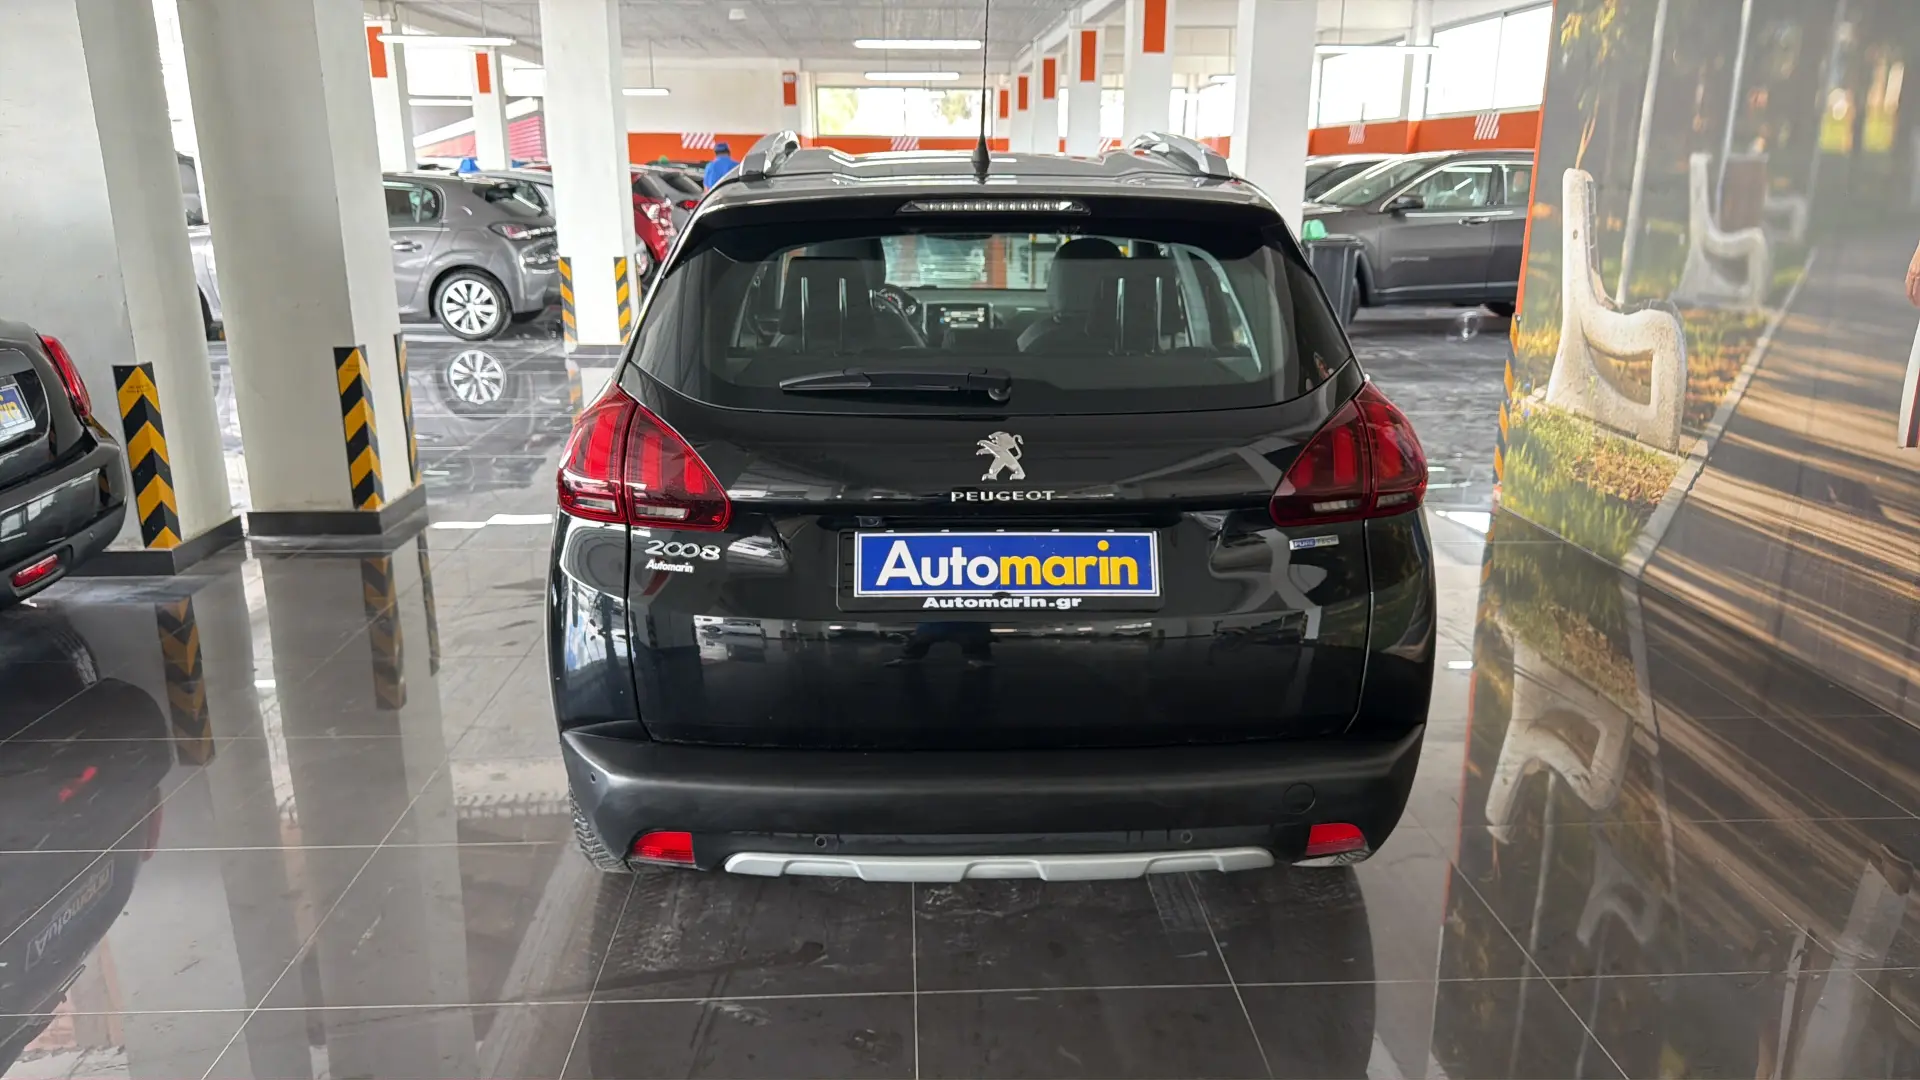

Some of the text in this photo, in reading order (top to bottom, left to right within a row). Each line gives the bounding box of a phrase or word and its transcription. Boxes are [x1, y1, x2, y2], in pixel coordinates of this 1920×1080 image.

[951, 490, 1056, 502] PEUGEOT
[644, 540, 721, 560] 2008
[645, 559, 694, 573] Automarin
[875, 540, 1139, 586] Automarin
[922, 596, 1082, 610] Automarin.gr
